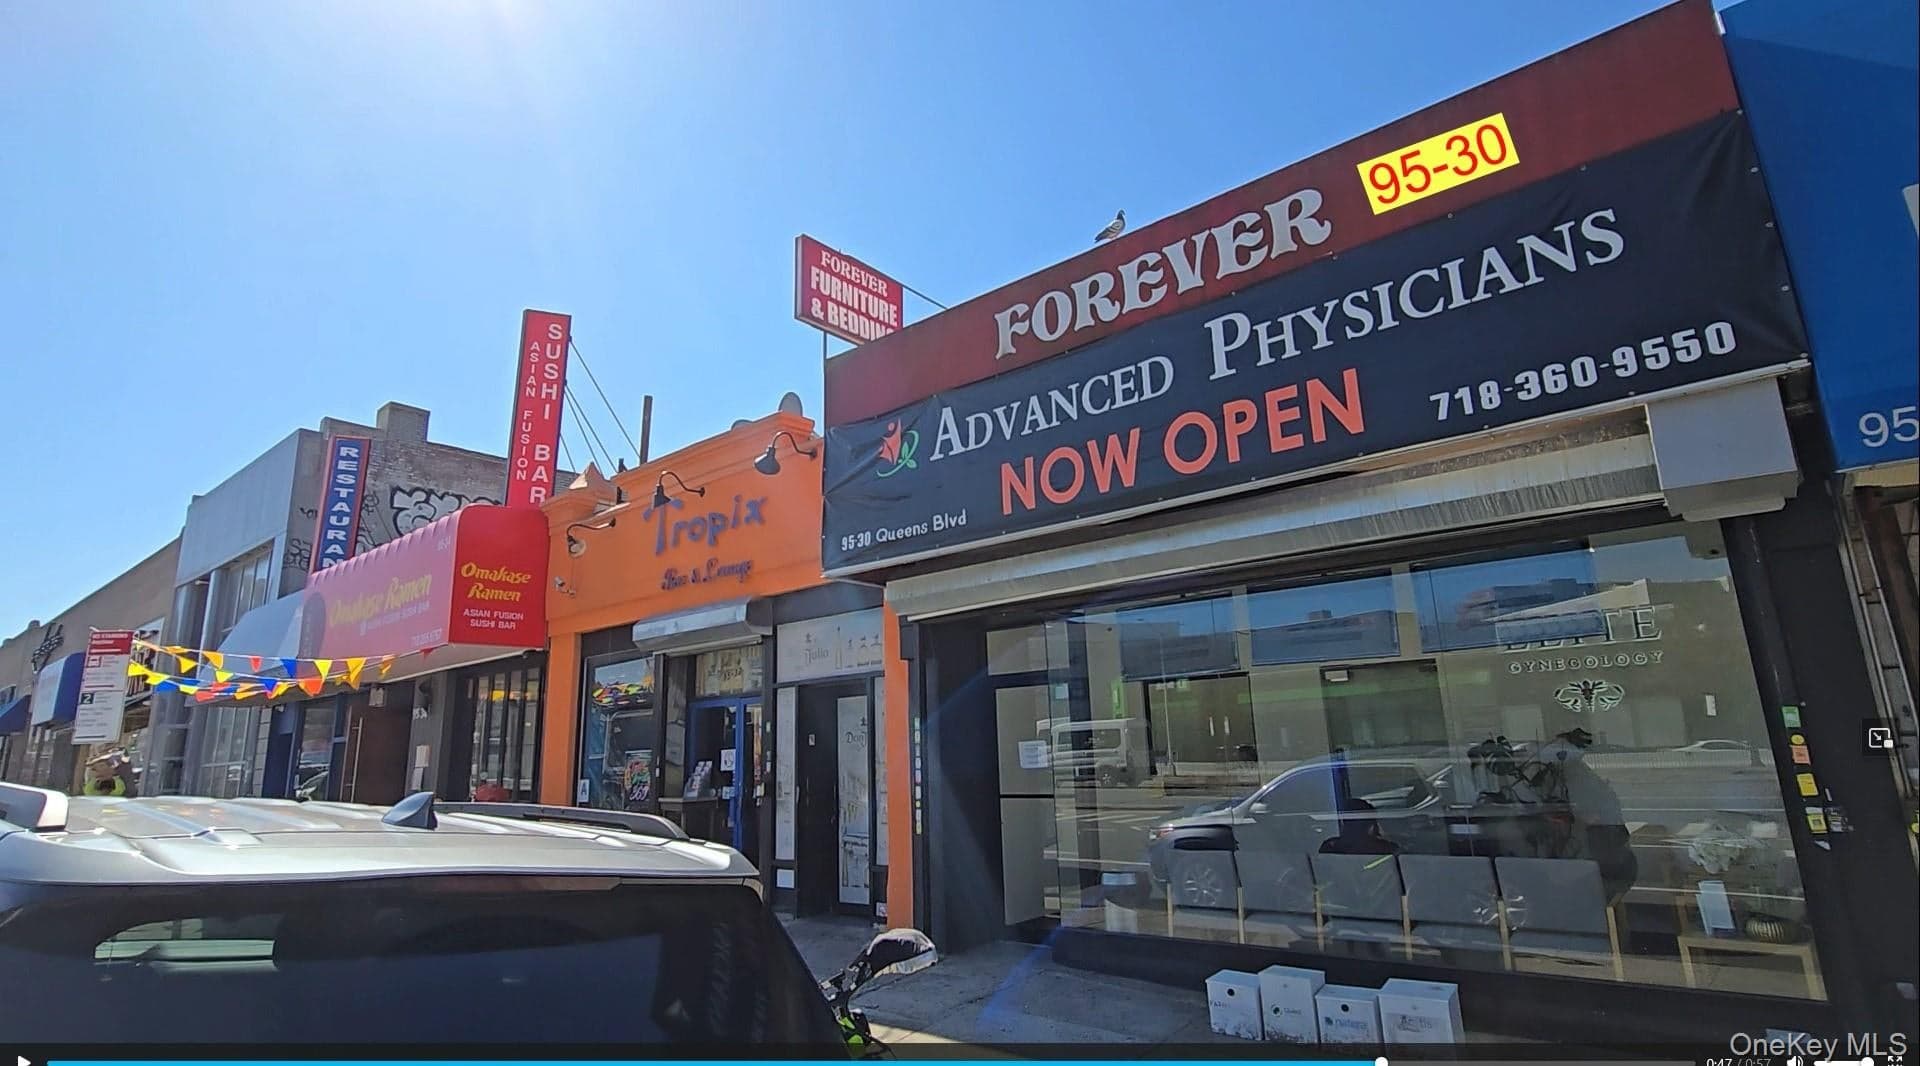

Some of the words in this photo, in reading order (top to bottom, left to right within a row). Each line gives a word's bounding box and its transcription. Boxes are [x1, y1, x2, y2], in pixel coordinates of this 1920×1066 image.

[810, 265, 898, 327] FURNITURE
[821, 249, 888, 297] FOREVER
[994, 186, 1332, 360] FOREVER
[811, 297, 825, 320] &
[827, 301, 894, 341] BEDDIN
[929, 354, 1174, 461] ADVANCED
[1203, 207, 1626, 381] PHYSICIANS
[525, 341, 540, 397] ASIAN
[541, 323, 563, 420] SUSHI
[1429, 320, 1738, 421] 718-360-9550
[516, 410, 533, 481] FUSION
[1000, 426, 1141, 516] NOW
[1162, 367, 1367, 475] OPEN
[1858, 405, 1919, 448] 95
[529, 444, 550, 505] BAR
[642, 494, 768, 557] Tropix
[841, 531, 872, 551] 95-30
[876, 523, 928, 543] Queens
[932, 509, 967, 532] Blvd
[460, 561, 532, 584] Omakase
[467, 582, 522, 602] Ramen
[463, 608, 491, 618] ASIAN
[493, 611, 524, 621] FUSION
[470, 619, 496, 628] SUSHI
[498, 621, 516, 630] BAR
[1508, 651, 1664, 675] GYNECOLOGY
[83, 694, 92, 704] 2
